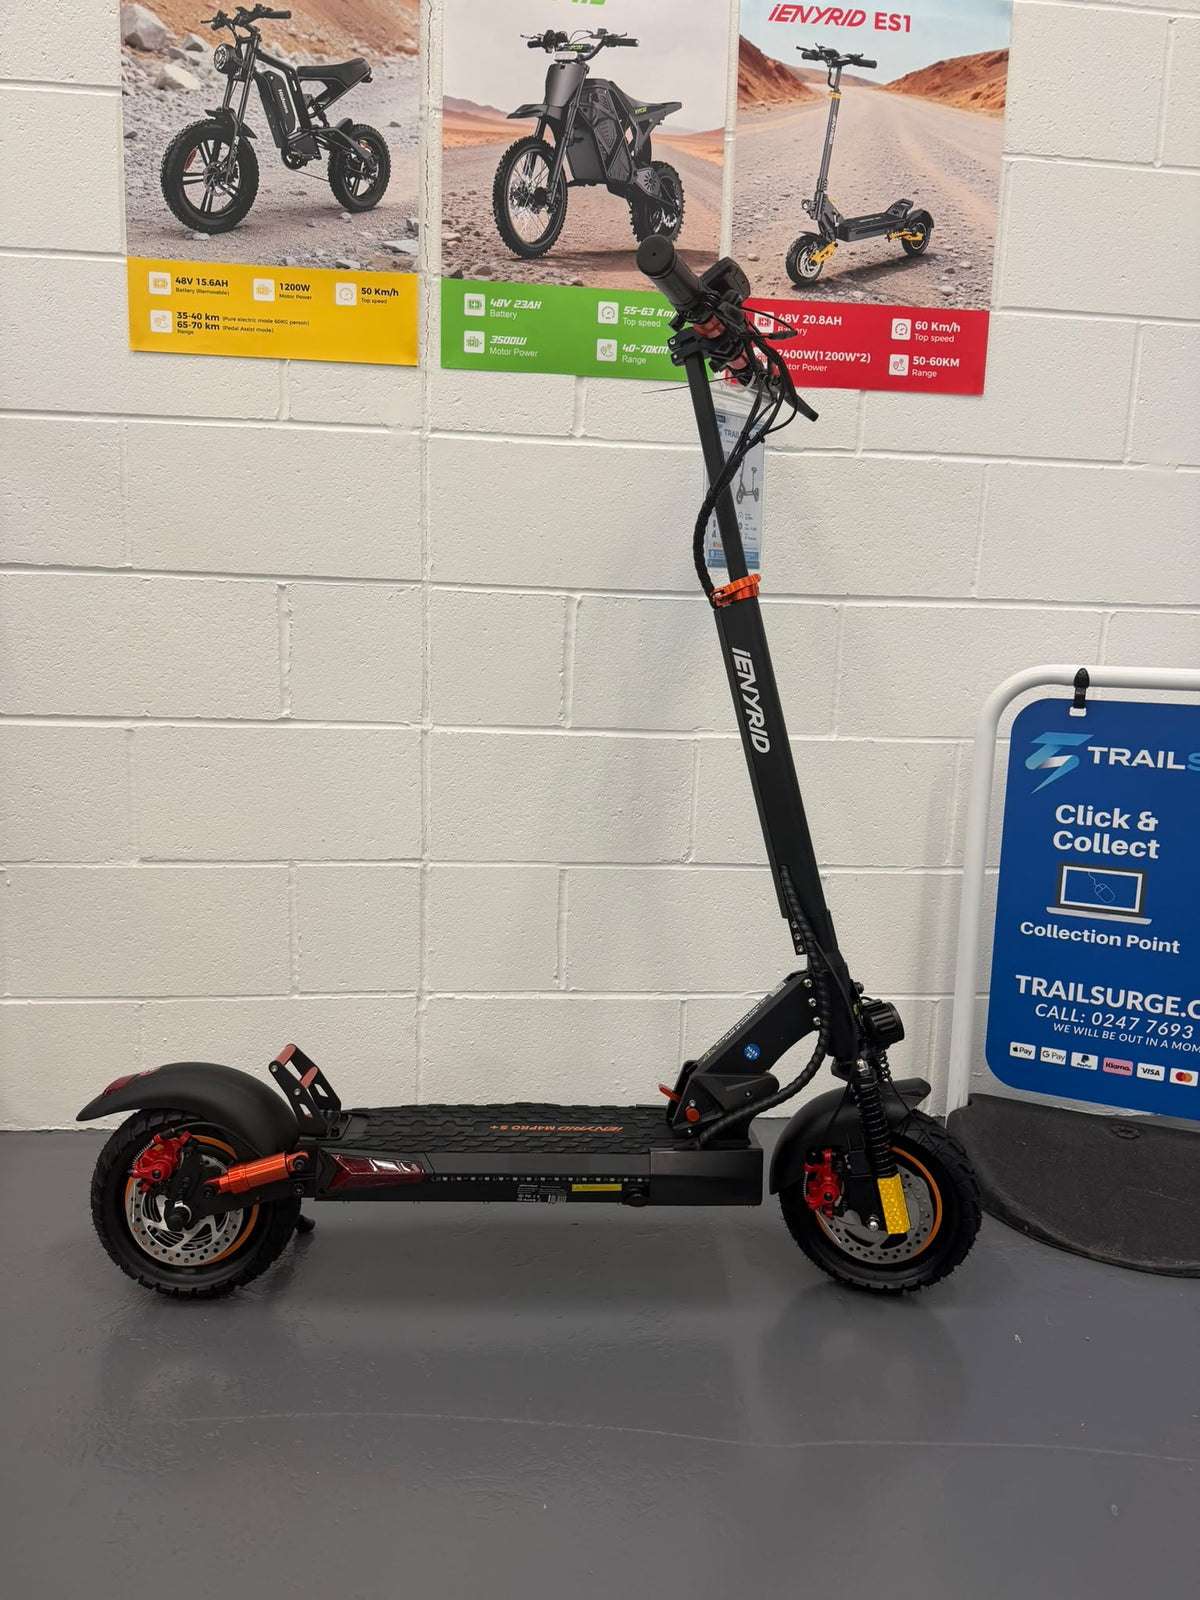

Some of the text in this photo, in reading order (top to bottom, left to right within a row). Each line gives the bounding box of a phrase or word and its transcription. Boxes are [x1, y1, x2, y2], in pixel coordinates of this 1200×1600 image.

[874, 12, 912, 32] ES1
[176, 277, 228, 288] 48V 15.6AH
[280, 282, 310, 292] 1200W
[361, 287, 399, 298] 50 Km/h
[514, 300, 542, 310] 23AH
[177, 312, 202, 320] 35-40
[205, 313, 220, 321] km
[490, 310, 518, 320] Battery
[623, 306, 679, 318] 55-63 Km/
[177, 320, 202, 330] 65-70
[205, 322, 220, 330] km
[622, 318, 661, 328] Top speed
[778, 314, 842, 326] 48V 20.8AH
[914, 321, 960, 332] 60 Km/h
[490, 336, 527, 346] 3500W
[914, 333, 954, 344] Top speed
[490, 347, 538, 358] Motor Power
[622, 355, 646, 364] Range
[912, 356, 960, 368] 50-60KM
[802, 363, 828, 372] Power
[912, 369, 937, 378] Range
[1055, 804, 1158, 832] Click &
[1053, 830, 1160, 859] Collect
[1020, 922, 1180, 954] Collection Point
[1035, 1004, 1194, 1039] CALL: 0247 7693
[1053, 1022, 1070, 1033] WE
[1073, 1025, 1099, 1038] WILL
[1102, 1030, 1116, 1040] BE
[1119, 1033, 1143, 1044] OUT
[1146, 1037, 1158, 1046] IN
[1160, 1040, 1168, 1048] A
[1019, 1046, 1032, 1056] Pay
[1052, 1052, 1065, 1062] Pay
[1141, 1067, 1160, 1076] VISA
